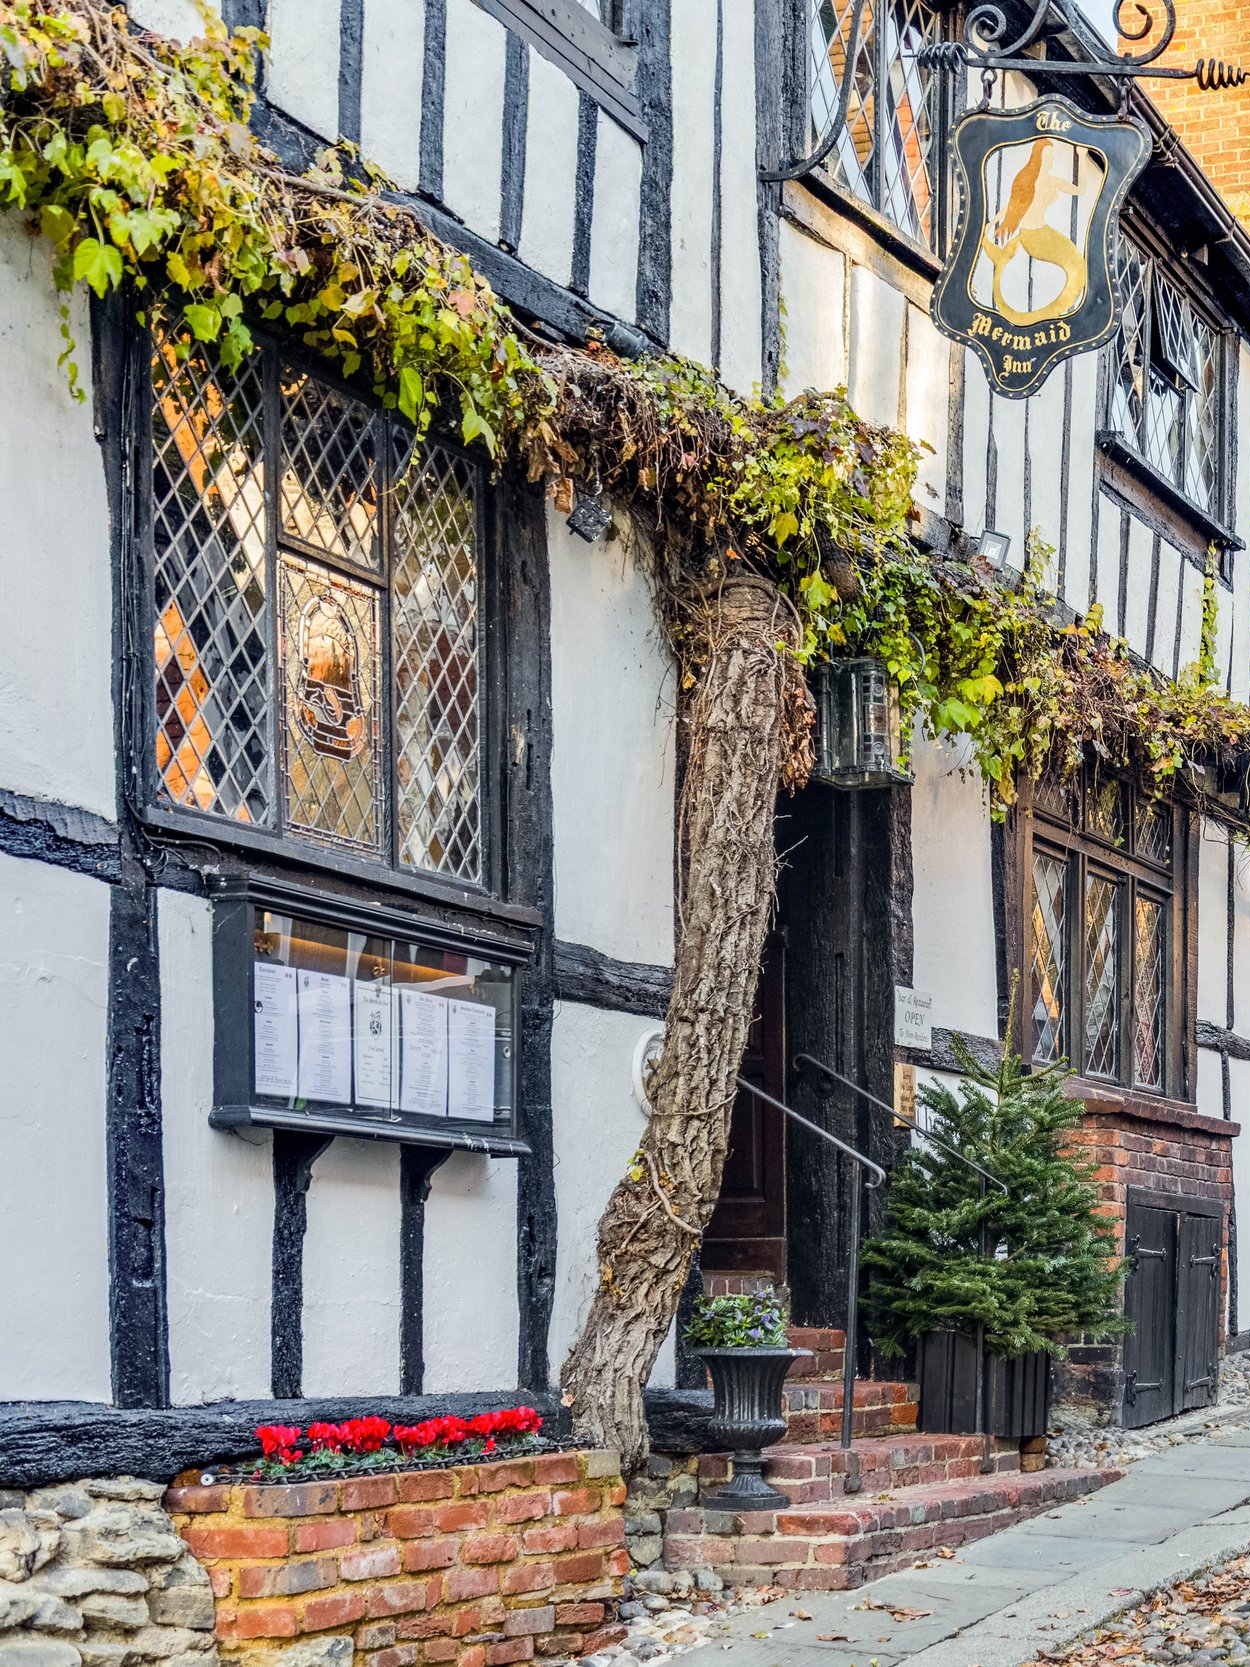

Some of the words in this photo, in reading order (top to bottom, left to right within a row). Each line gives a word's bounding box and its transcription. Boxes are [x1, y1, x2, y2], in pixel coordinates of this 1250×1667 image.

[1036, 110, 1071, 132] The
[967, 312, 1071, 350] Mermaid
[999, 354, 1033, 382] Inn
[905, 1010, 925, 1026] OPEN
